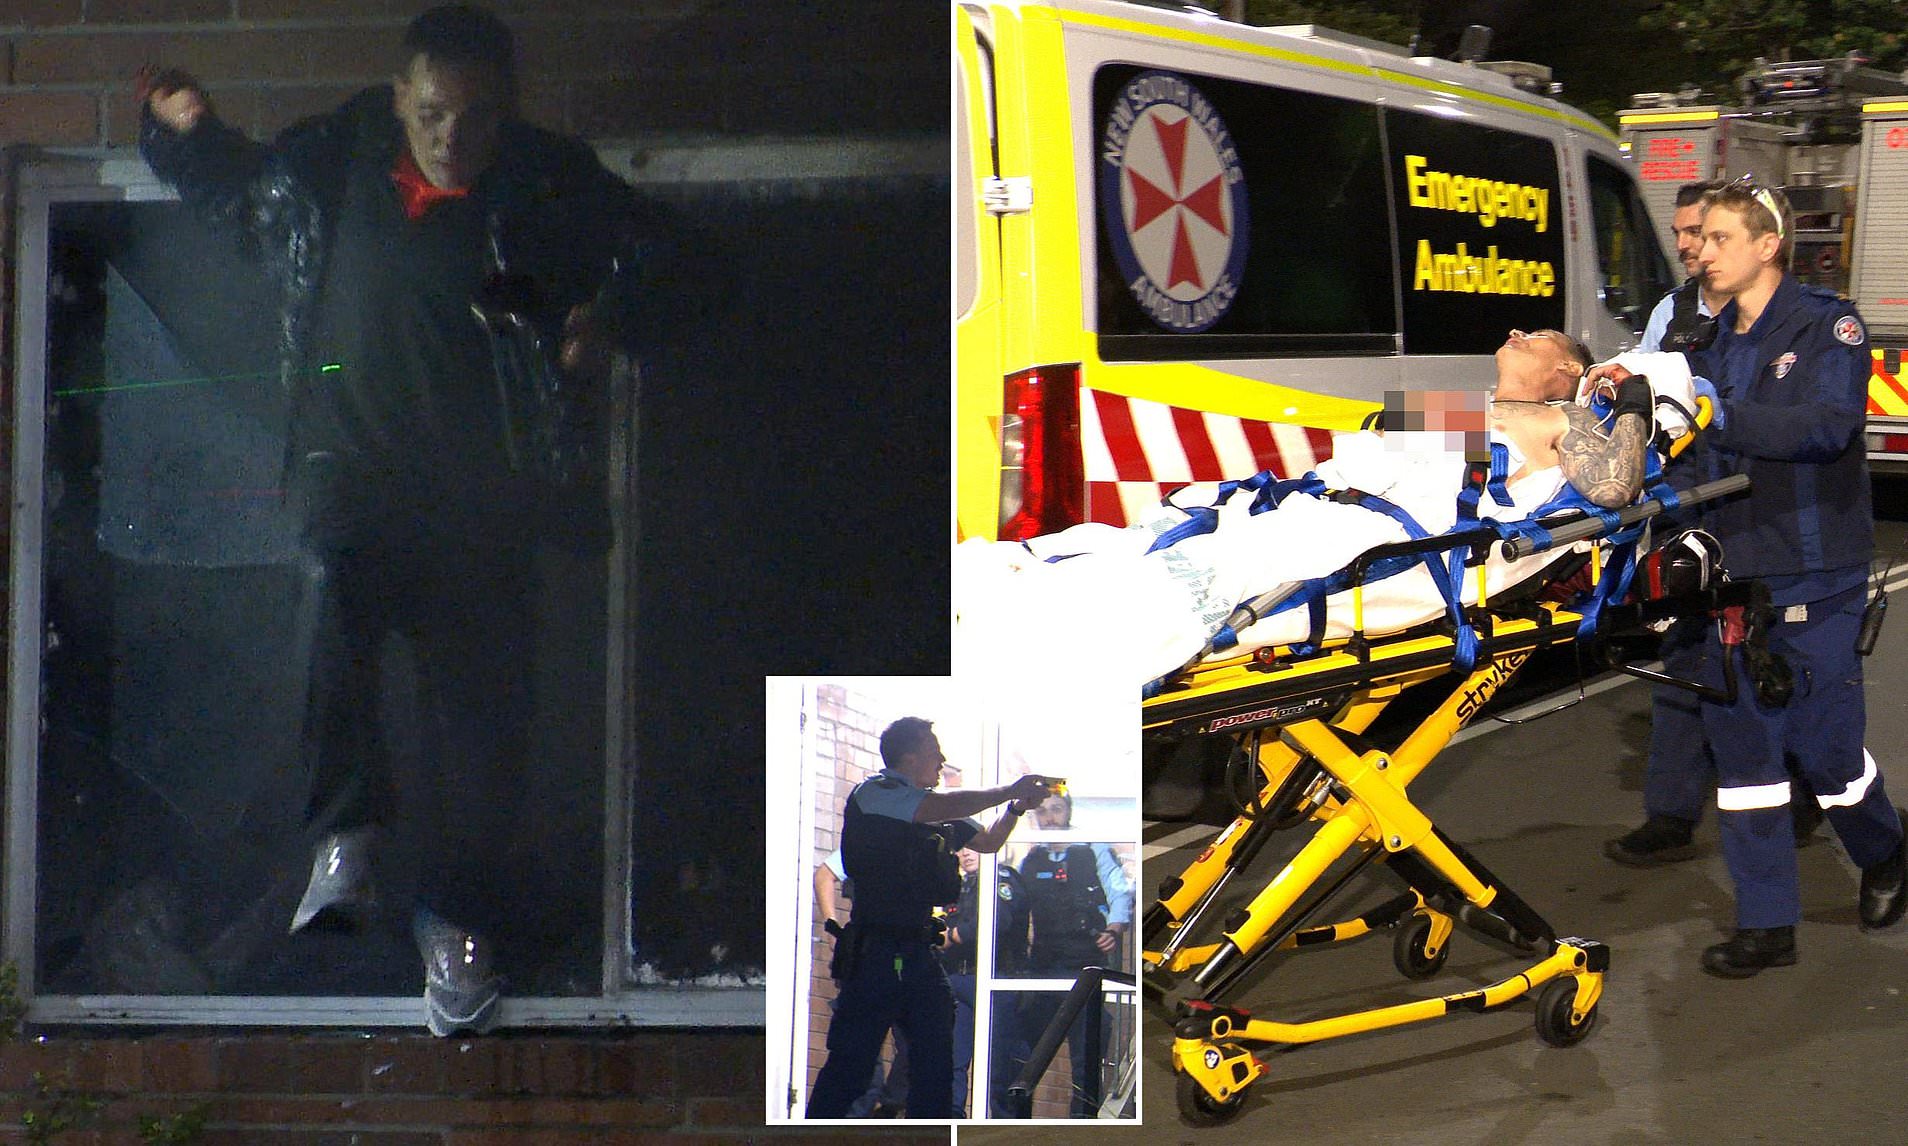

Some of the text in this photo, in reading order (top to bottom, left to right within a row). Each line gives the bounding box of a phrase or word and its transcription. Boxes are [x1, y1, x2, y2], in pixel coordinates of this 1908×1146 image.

[1103, 76, 1244, 185] NEW SOUTH WALES
[1405, 155, 1549, 233] Emergency
[1414, 239, 1555, 297] Ambulance
[1130, 274, 1237, 328] AMBULANCE
[1208, 707, 1279, 733] power
[1276, 704, 1306, 719] pro
